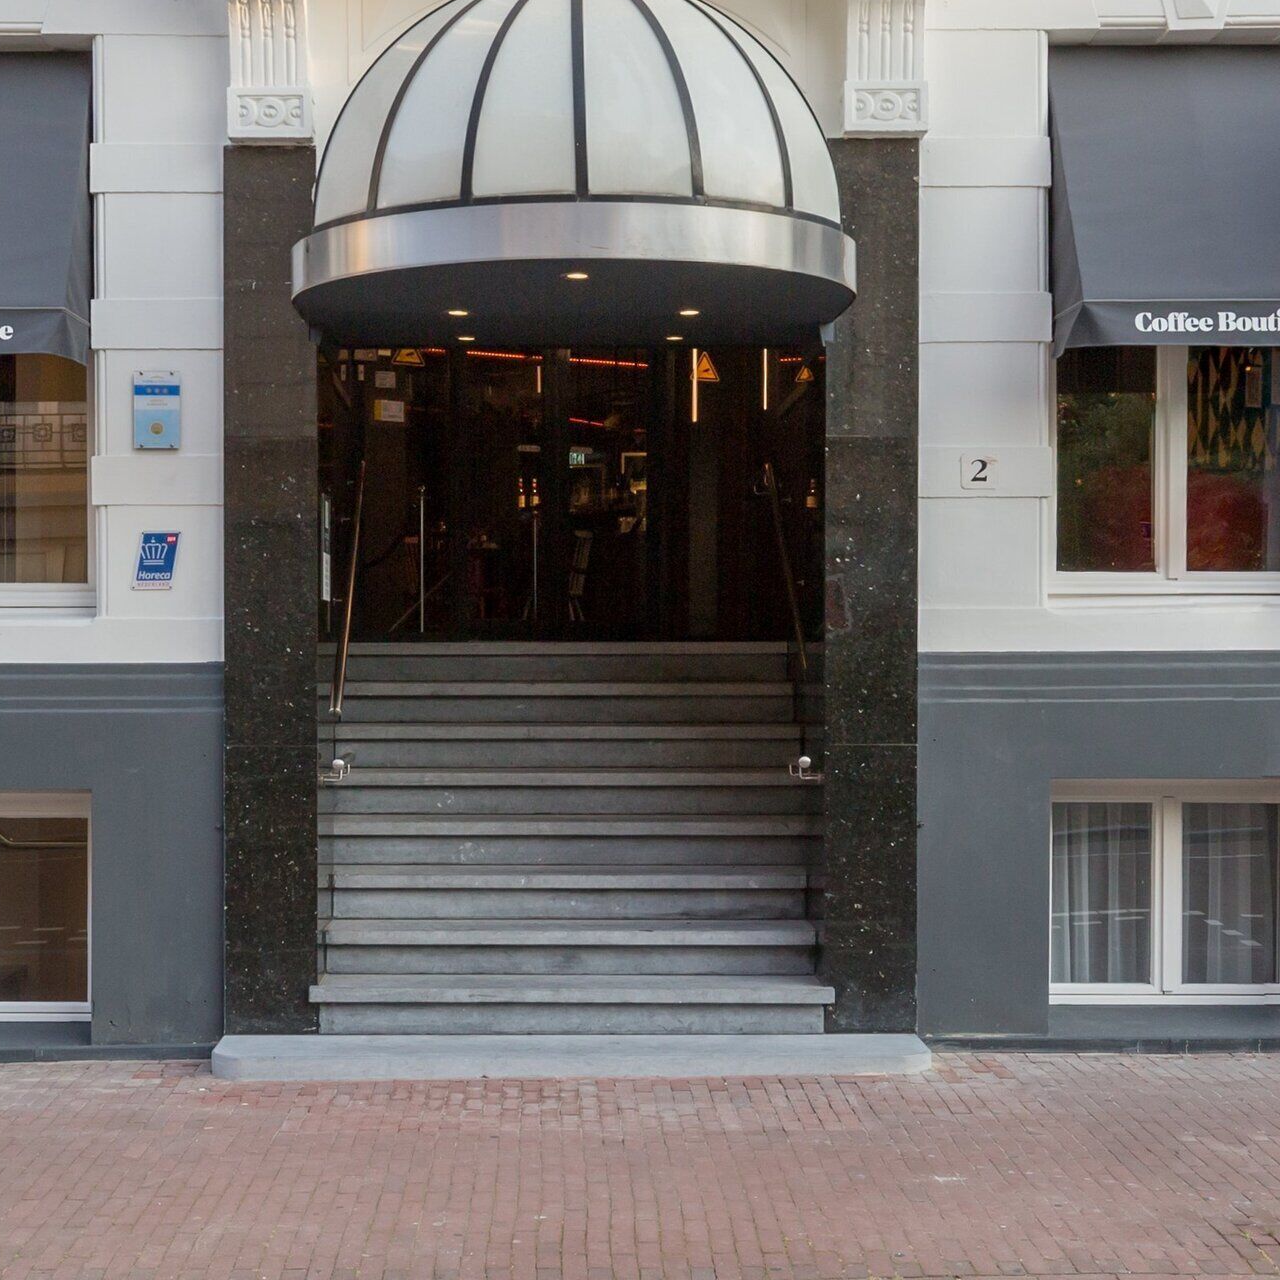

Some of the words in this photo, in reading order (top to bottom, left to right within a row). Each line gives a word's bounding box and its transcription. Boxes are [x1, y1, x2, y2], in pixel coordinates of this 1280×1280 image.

[1134, 311, 1214, 333] Coffee
[970, 459, 988, 482] 2
[138, 571, 171, 580] Horeca
